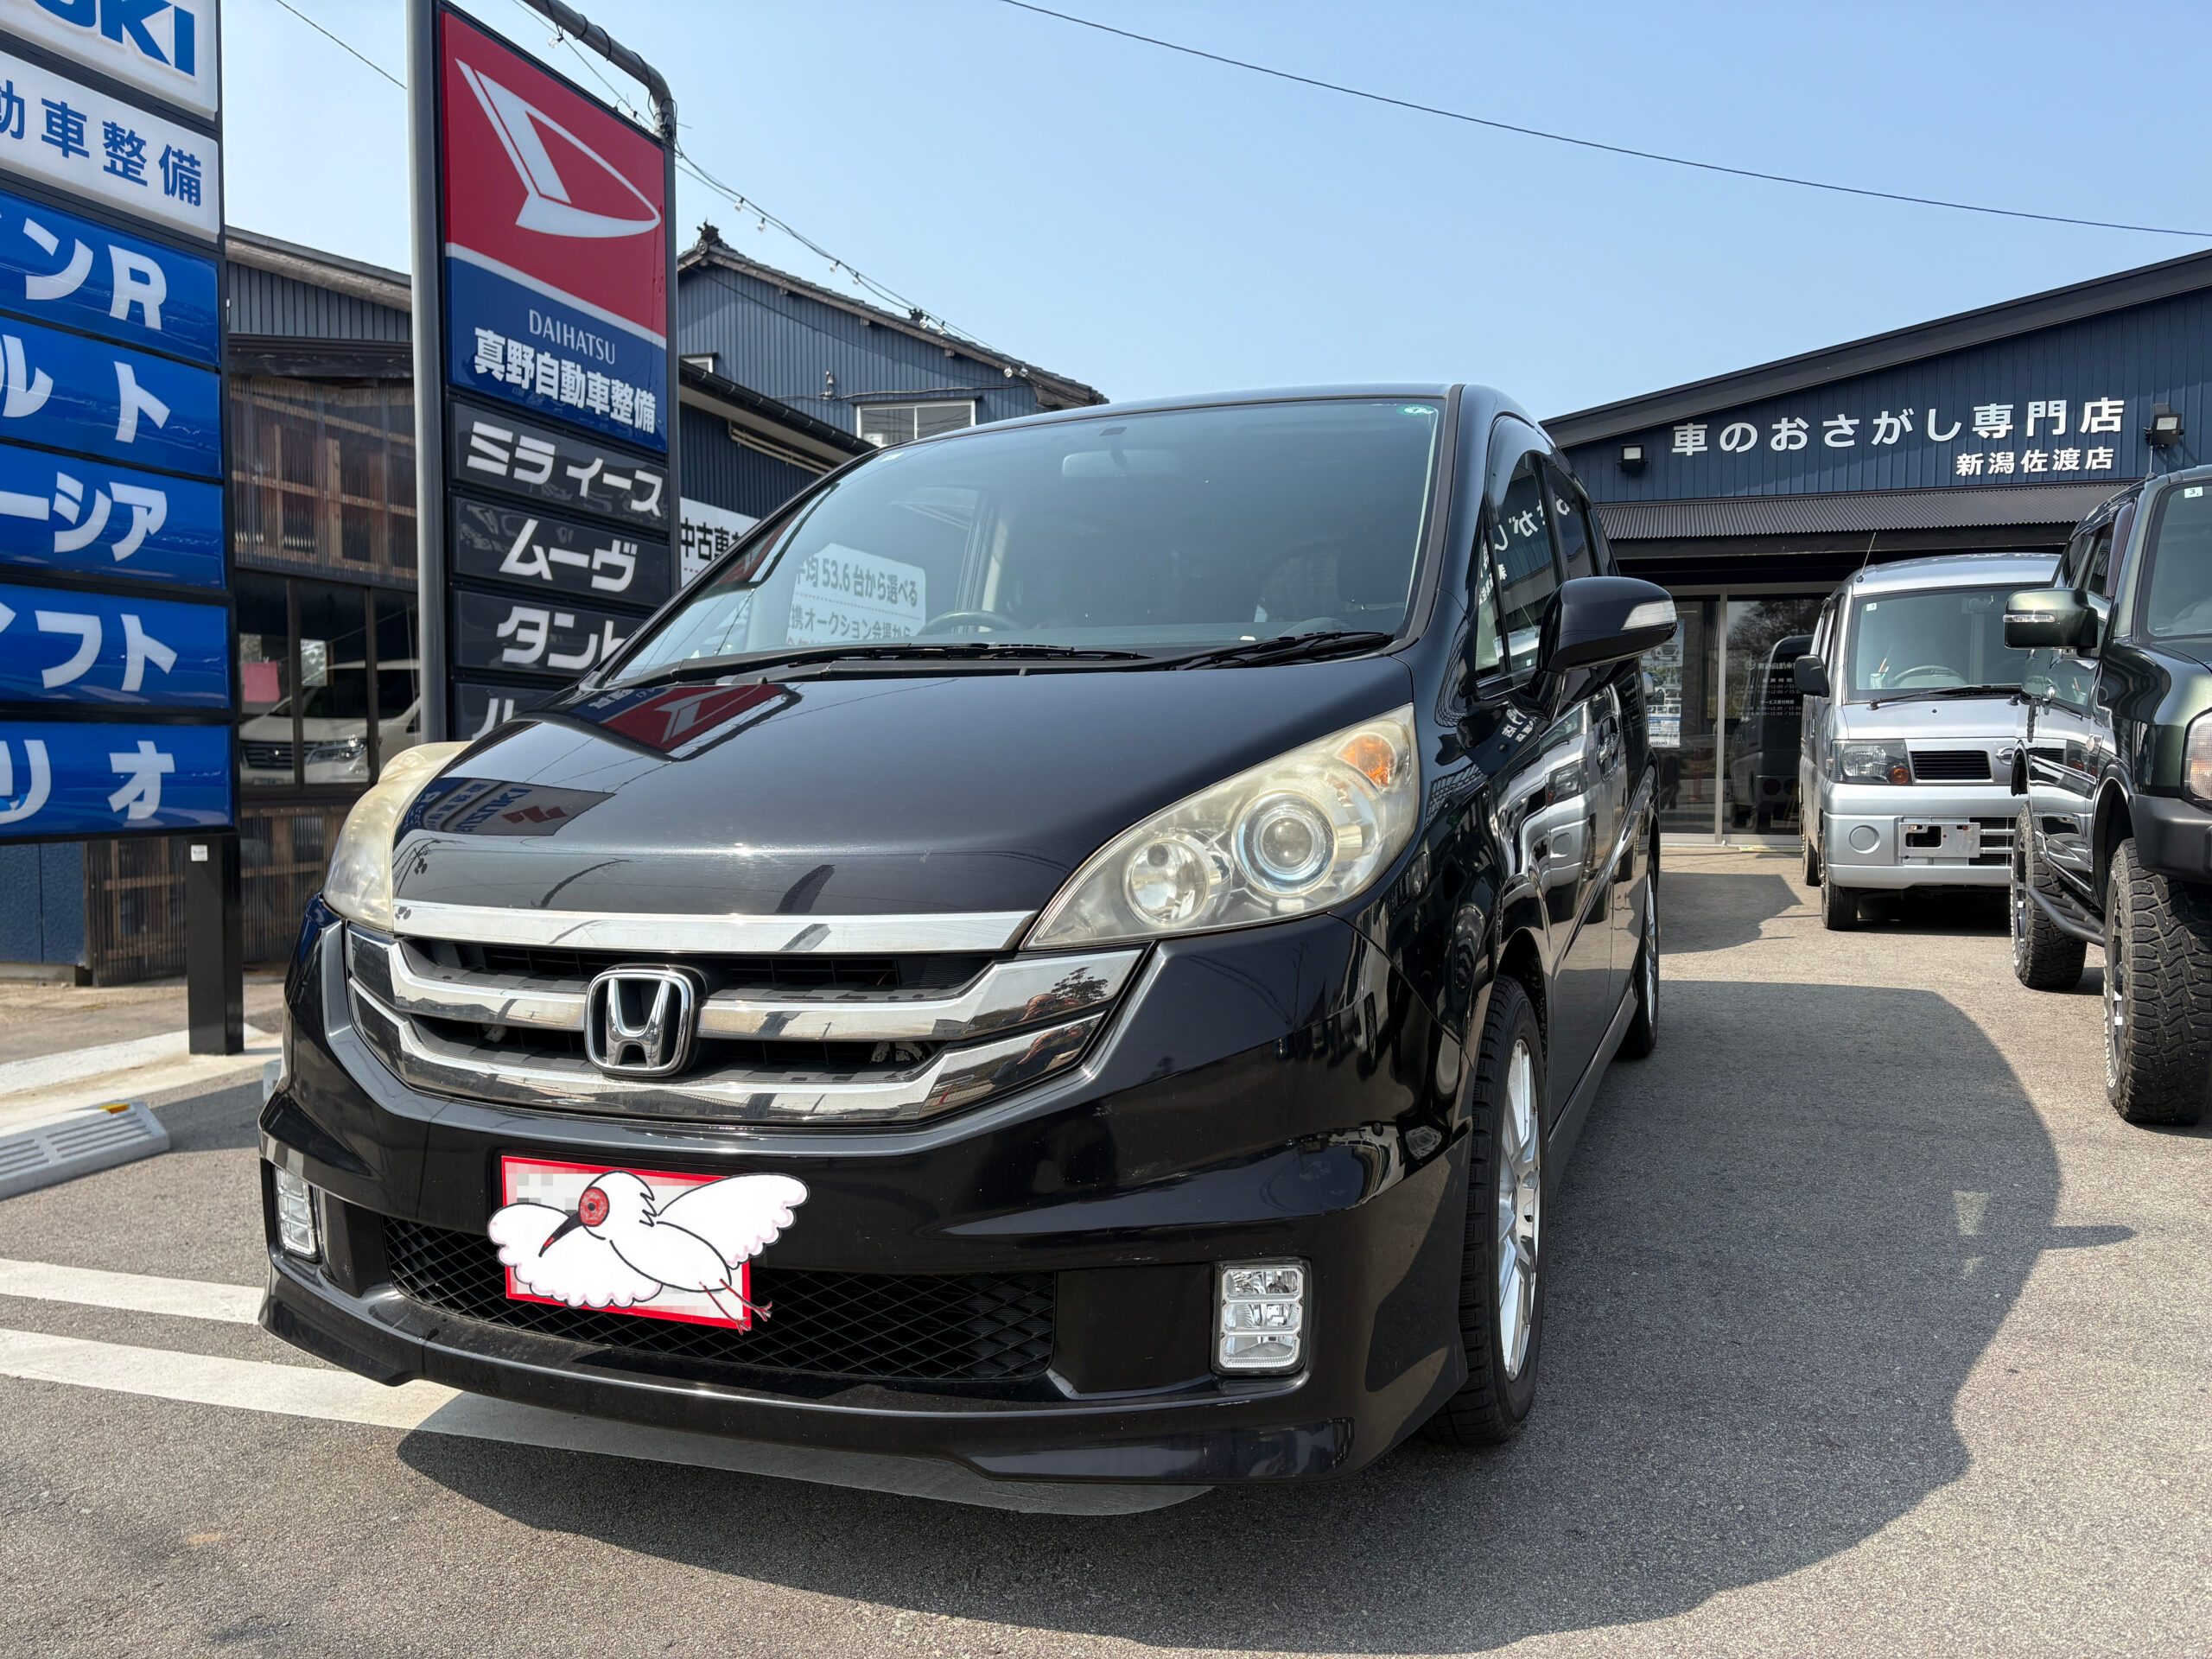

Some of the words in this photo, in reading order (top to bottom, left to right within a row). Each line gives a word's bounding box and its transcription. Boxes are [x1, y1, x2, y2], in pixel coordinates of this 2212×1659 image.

[529, 308, 615, 365] DAIHATSU
[474, 326, 657, 435] 真野自動車整備
[1671, 396, 2126, 456] 車のおさがし専門店
[1955, 446, 2114, 477] 新潟佐渡店
[498, 518, 639, 593] ムーヴ
[0, 601, 178, 692] フト
